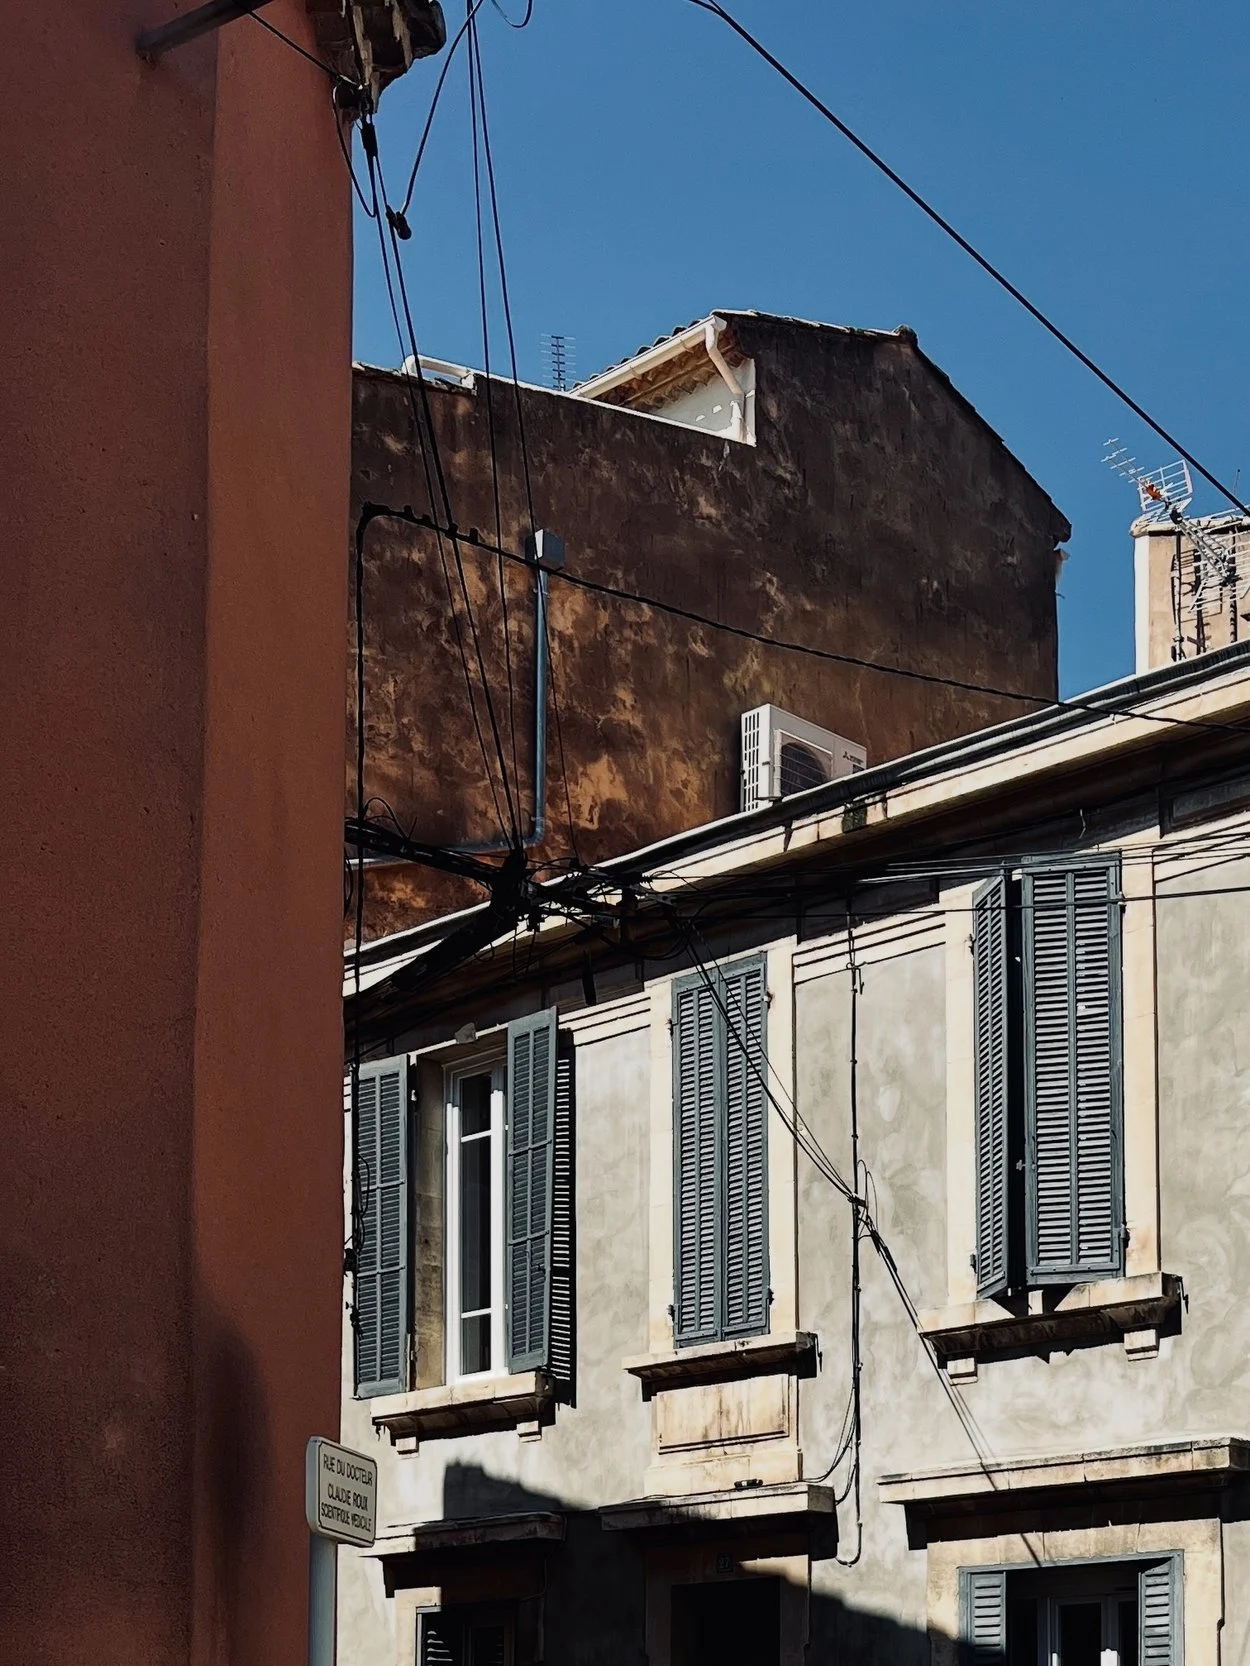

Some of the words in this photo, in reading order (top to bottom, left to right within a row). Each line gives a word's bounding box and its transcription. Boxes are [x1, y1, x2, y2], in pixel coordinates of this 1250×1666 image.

[323, 1454, 335, 1473] RUE
[337, 1460, 345, 1476] DU
[347, 1463, 372, 1487] DOCTEUR
[353, 1491, 368, 1512] ROUX
